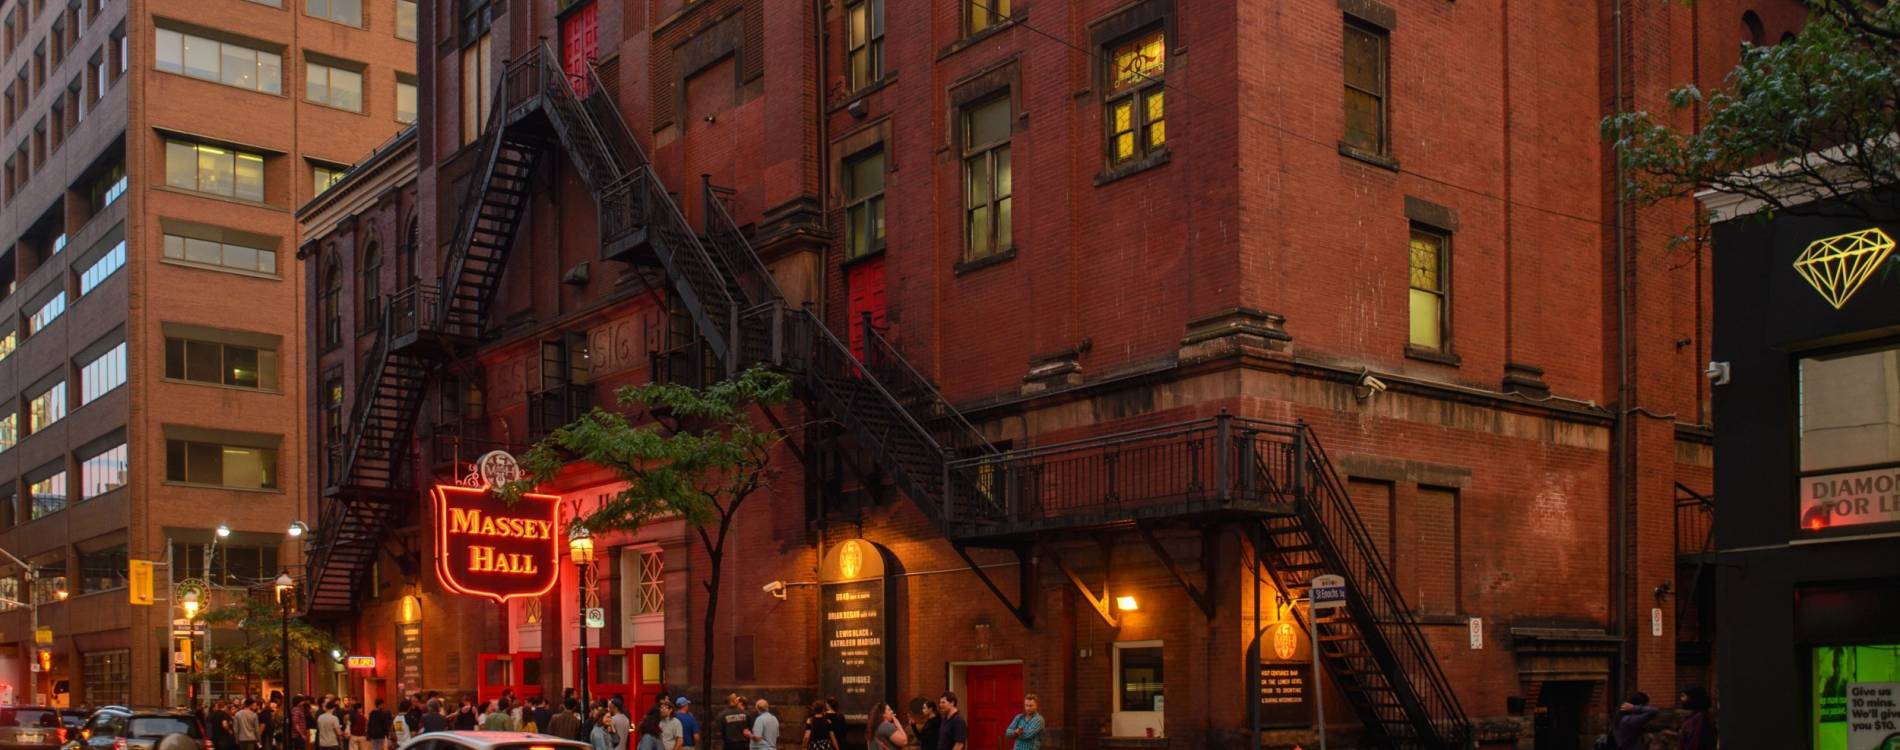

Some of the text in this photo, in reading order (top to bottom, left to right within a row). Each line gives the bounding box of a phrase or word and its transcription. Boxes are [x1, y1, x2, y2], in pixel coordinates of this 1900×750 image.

[1822, 497, 1870, 517] FOR
[449, 507, 553, 540] MASSEY
[468, 545, 539, 575] HALL
[1852, 687, 1892, 696] Give us
[1852, 698, 1865, 707] 10
[1867, 698, 1896, 707] mins.
[1852, 709, 1878, 718] We'll
[1852, 720, 1897, 732] you $10.
